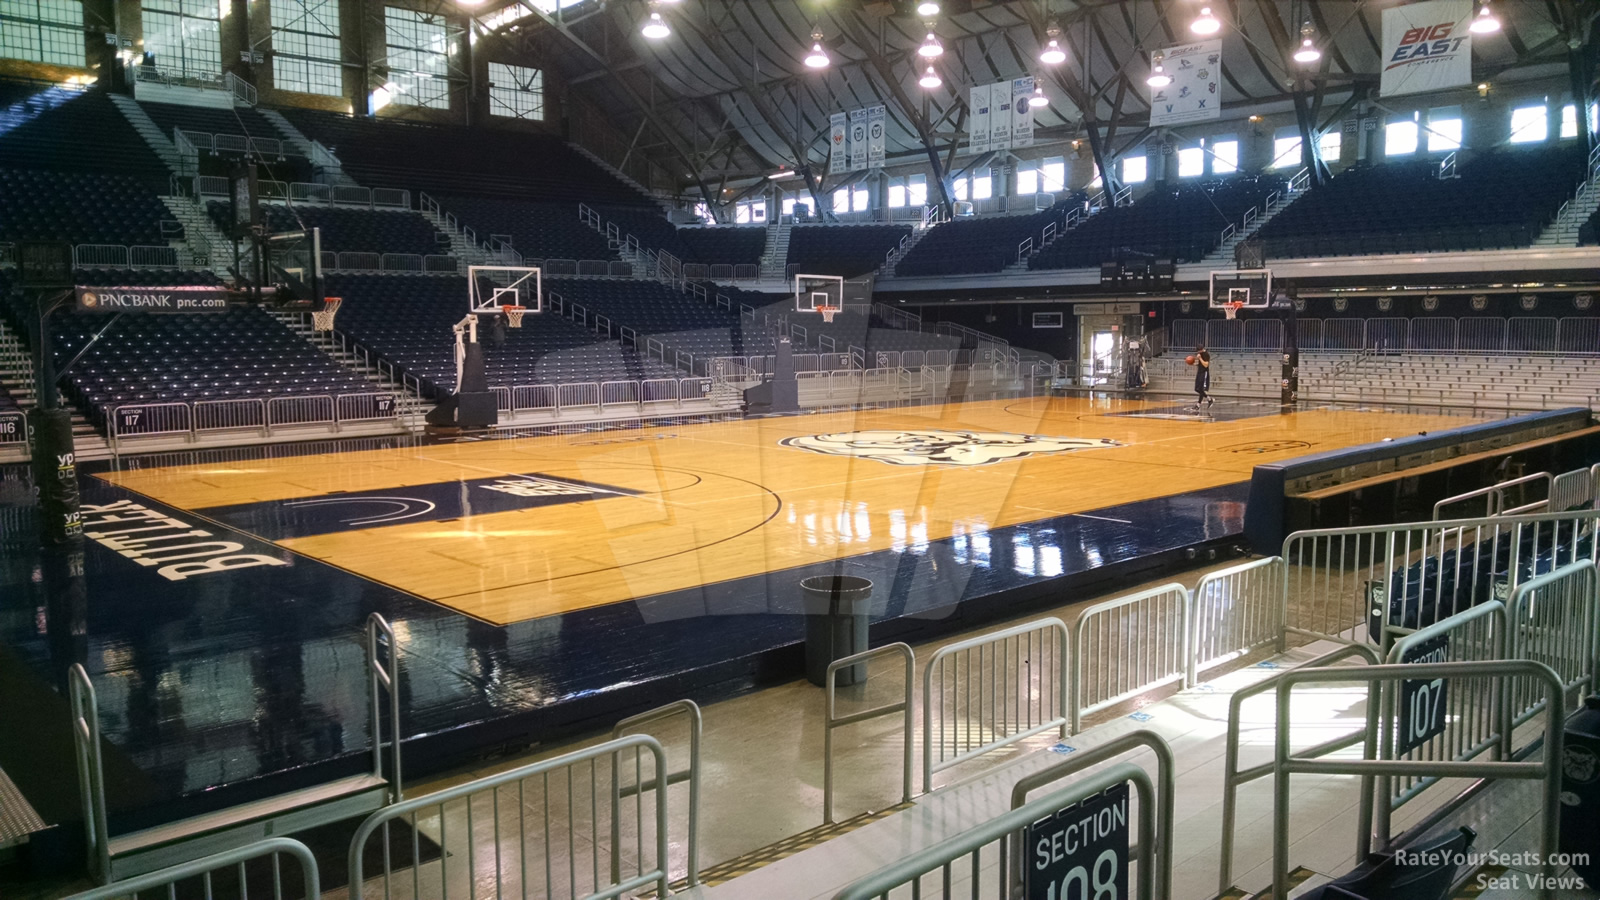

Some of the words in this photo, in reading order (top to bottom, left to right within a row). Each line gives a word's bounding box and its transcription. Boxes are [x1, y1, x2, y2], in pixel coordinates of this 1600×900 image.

[1399, 22, 1455, 46] BIG
[1390, 36, 1469, 62] EAST
[176, 298, 226, 309] pnc.com
[379, 401, 390, 410] 117
[0, 422, 16, 434] 116
[125, 415, 139, 426] 117
[80, 500, 288, 581] BUTLER
[1409, 678, 1443, 743] 107
[1036, 799, 1126, 870] SECTION
